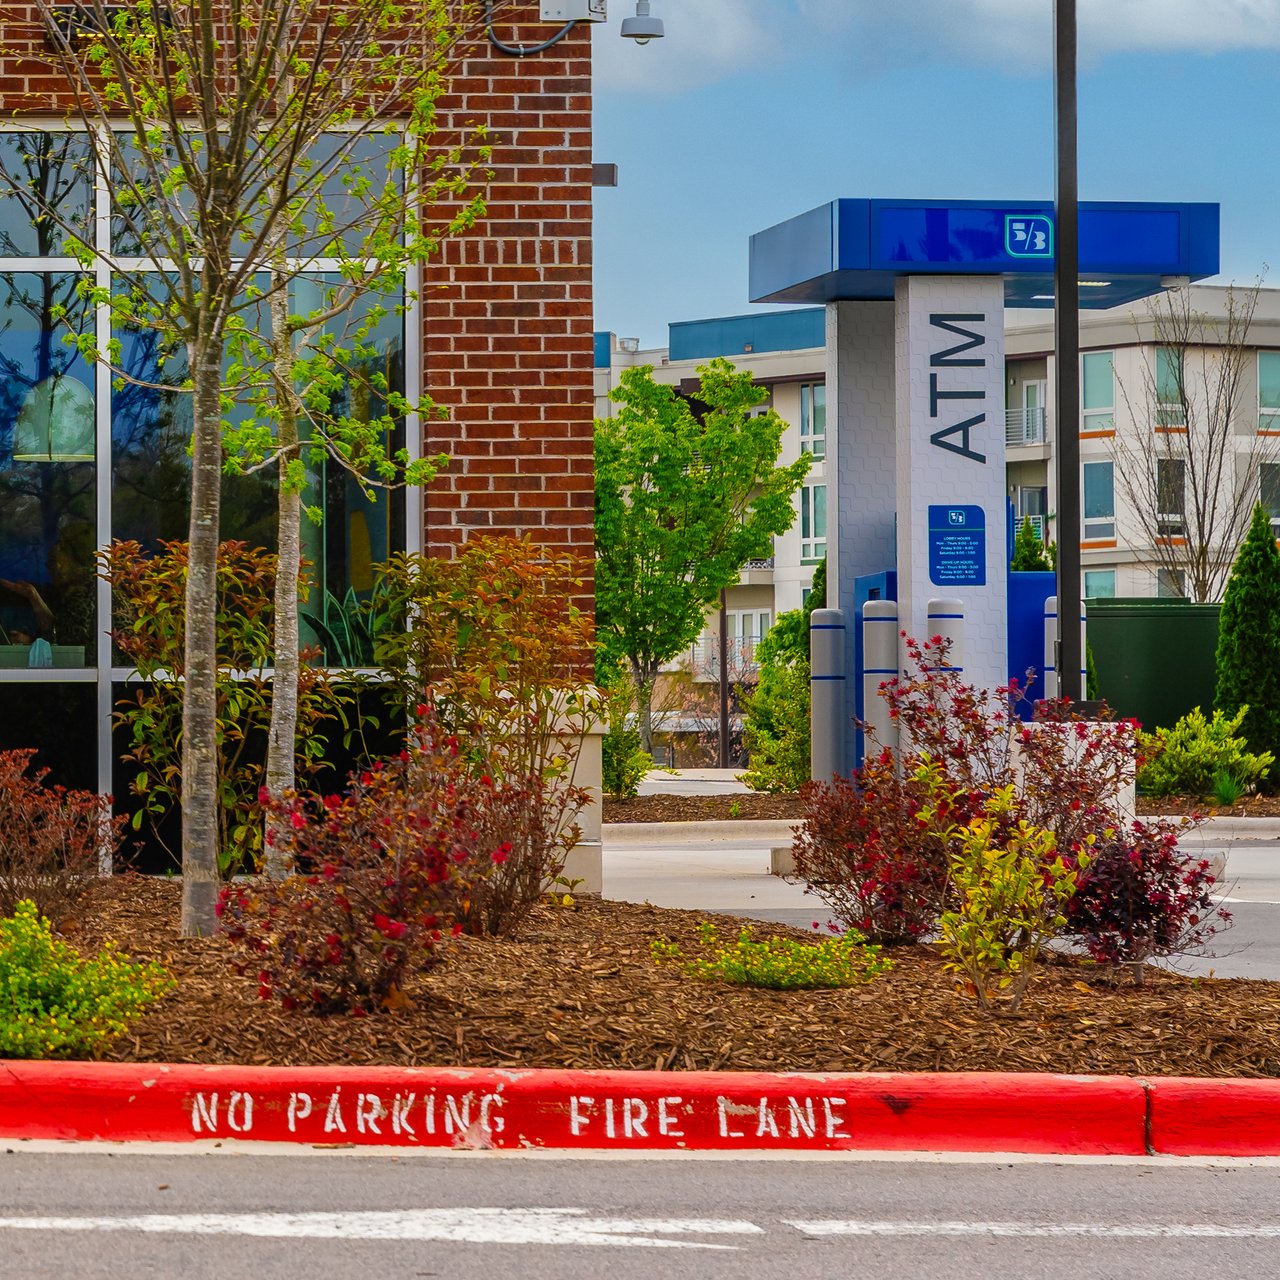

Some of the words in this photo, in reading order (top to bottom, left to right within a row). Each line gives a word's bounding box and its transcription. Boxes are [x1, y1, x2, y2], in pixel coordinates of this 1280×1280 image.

[929, 313, 986, 464] ATM
[192, 1091, 254, 1132] NO
[287, 1091, 505, 1135] PARKING
[570, 1096, 684, 1138] FIRE
[717, 1095, 851, 1138] LANE
